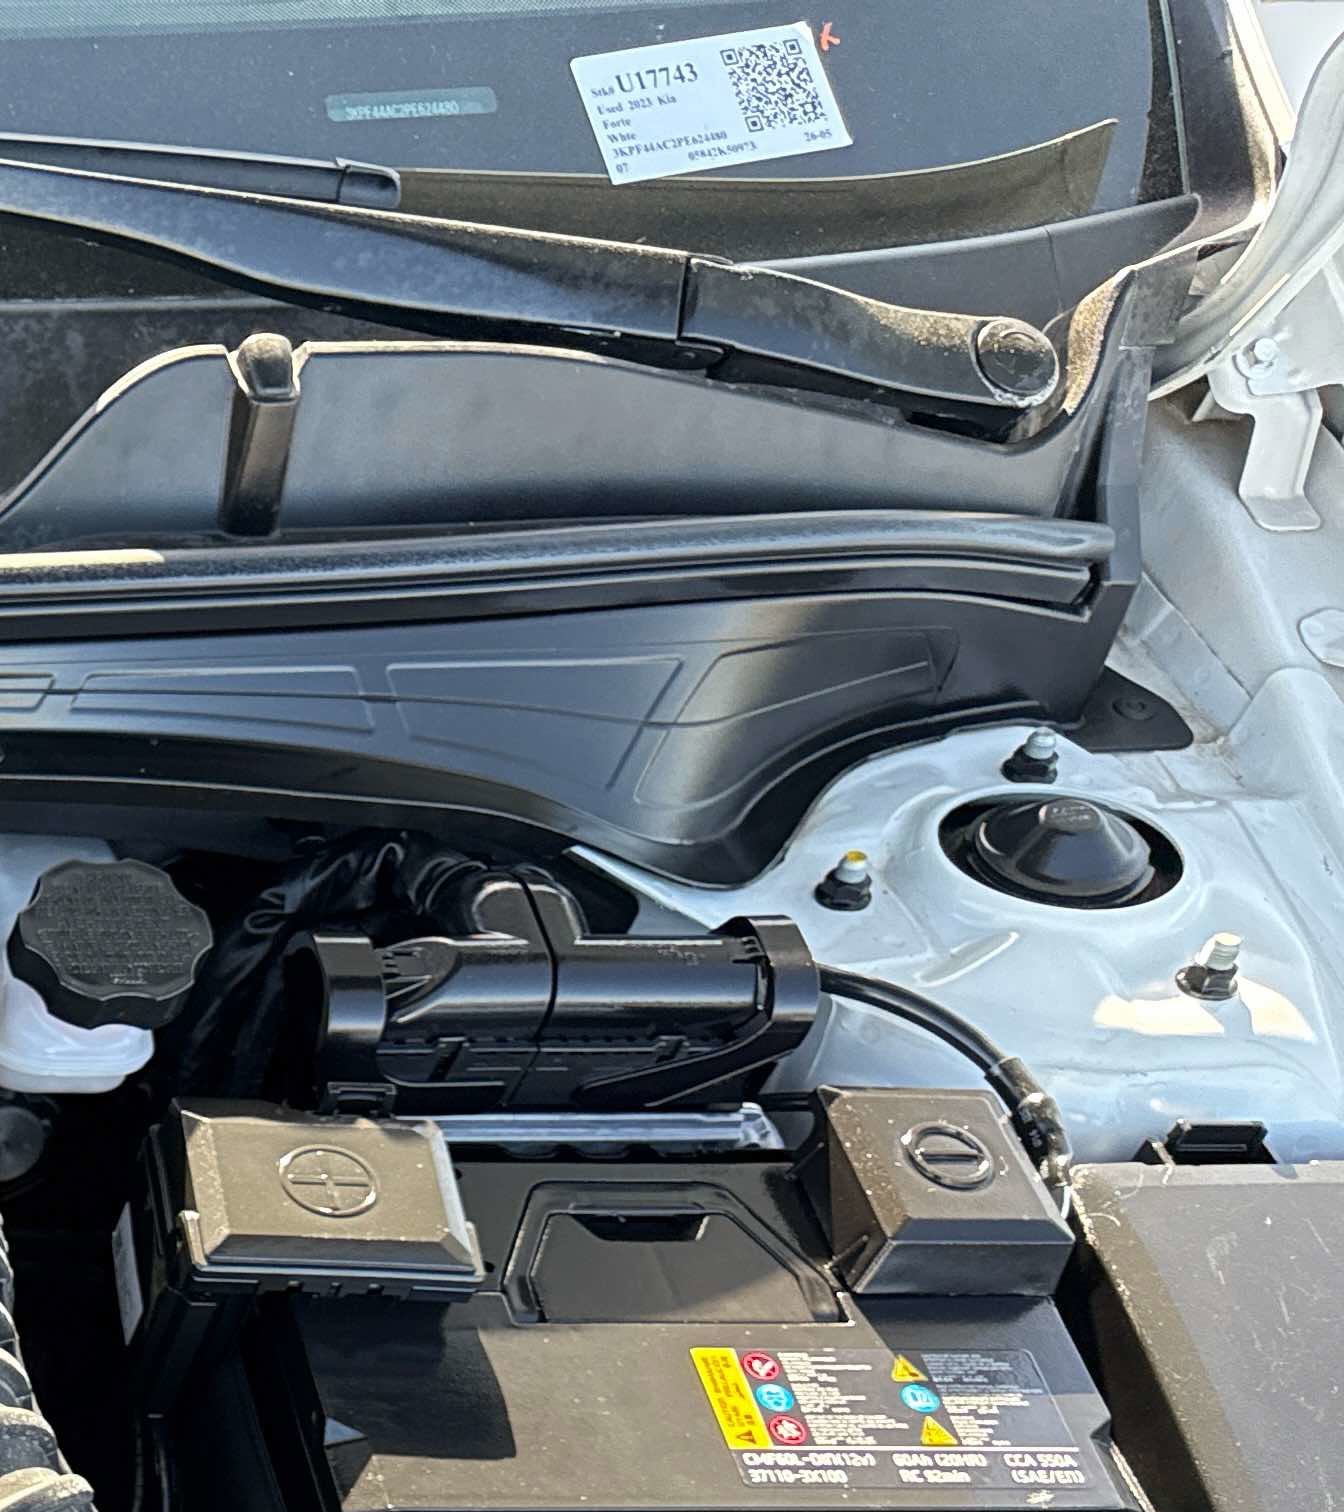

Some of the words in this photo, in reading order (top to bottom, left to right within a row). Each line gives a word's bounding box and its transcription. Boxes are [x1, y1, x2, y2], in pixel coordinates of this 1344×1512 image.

[615, 63, 698, 94] U17743
[597, 102, 623, 115] Used
[658, 94, 677, 106] Kia
[603, 117, 631, 130] Forte
[1003, 1453, 1038, 1467] CCA
